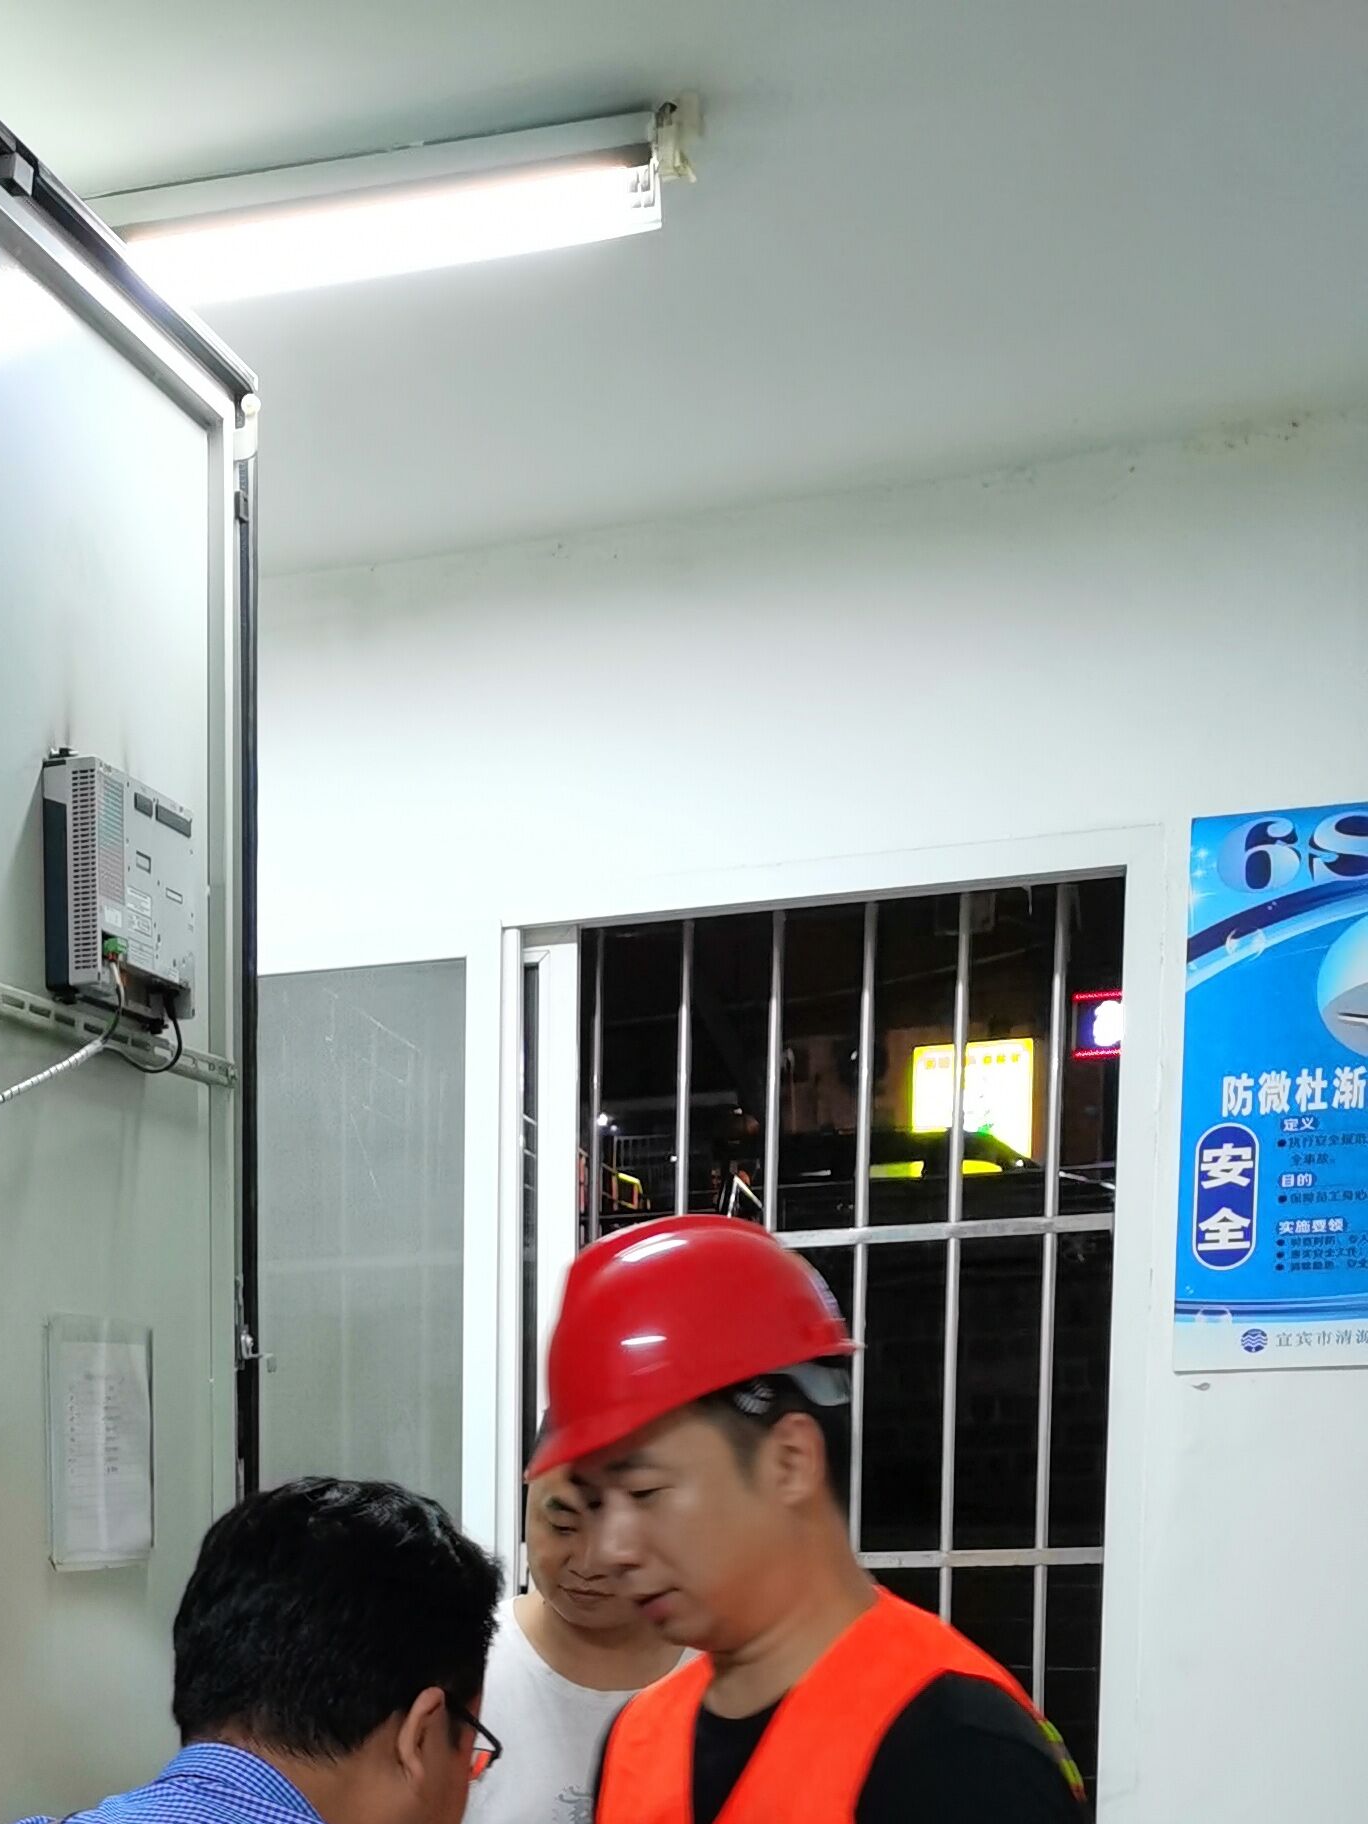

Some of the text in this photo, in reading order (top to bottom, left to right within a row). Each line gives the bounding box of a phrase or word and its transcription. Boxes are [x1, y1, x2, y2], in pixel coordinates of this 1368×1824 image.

[1221, 1066, 1368, 1117] 防微杜渐
[1283, 1117, 1315, 1131] 定义
[1197, 1143, 1254, 1251] 安全
[1282, 1173, 1313, 1188] 目的
